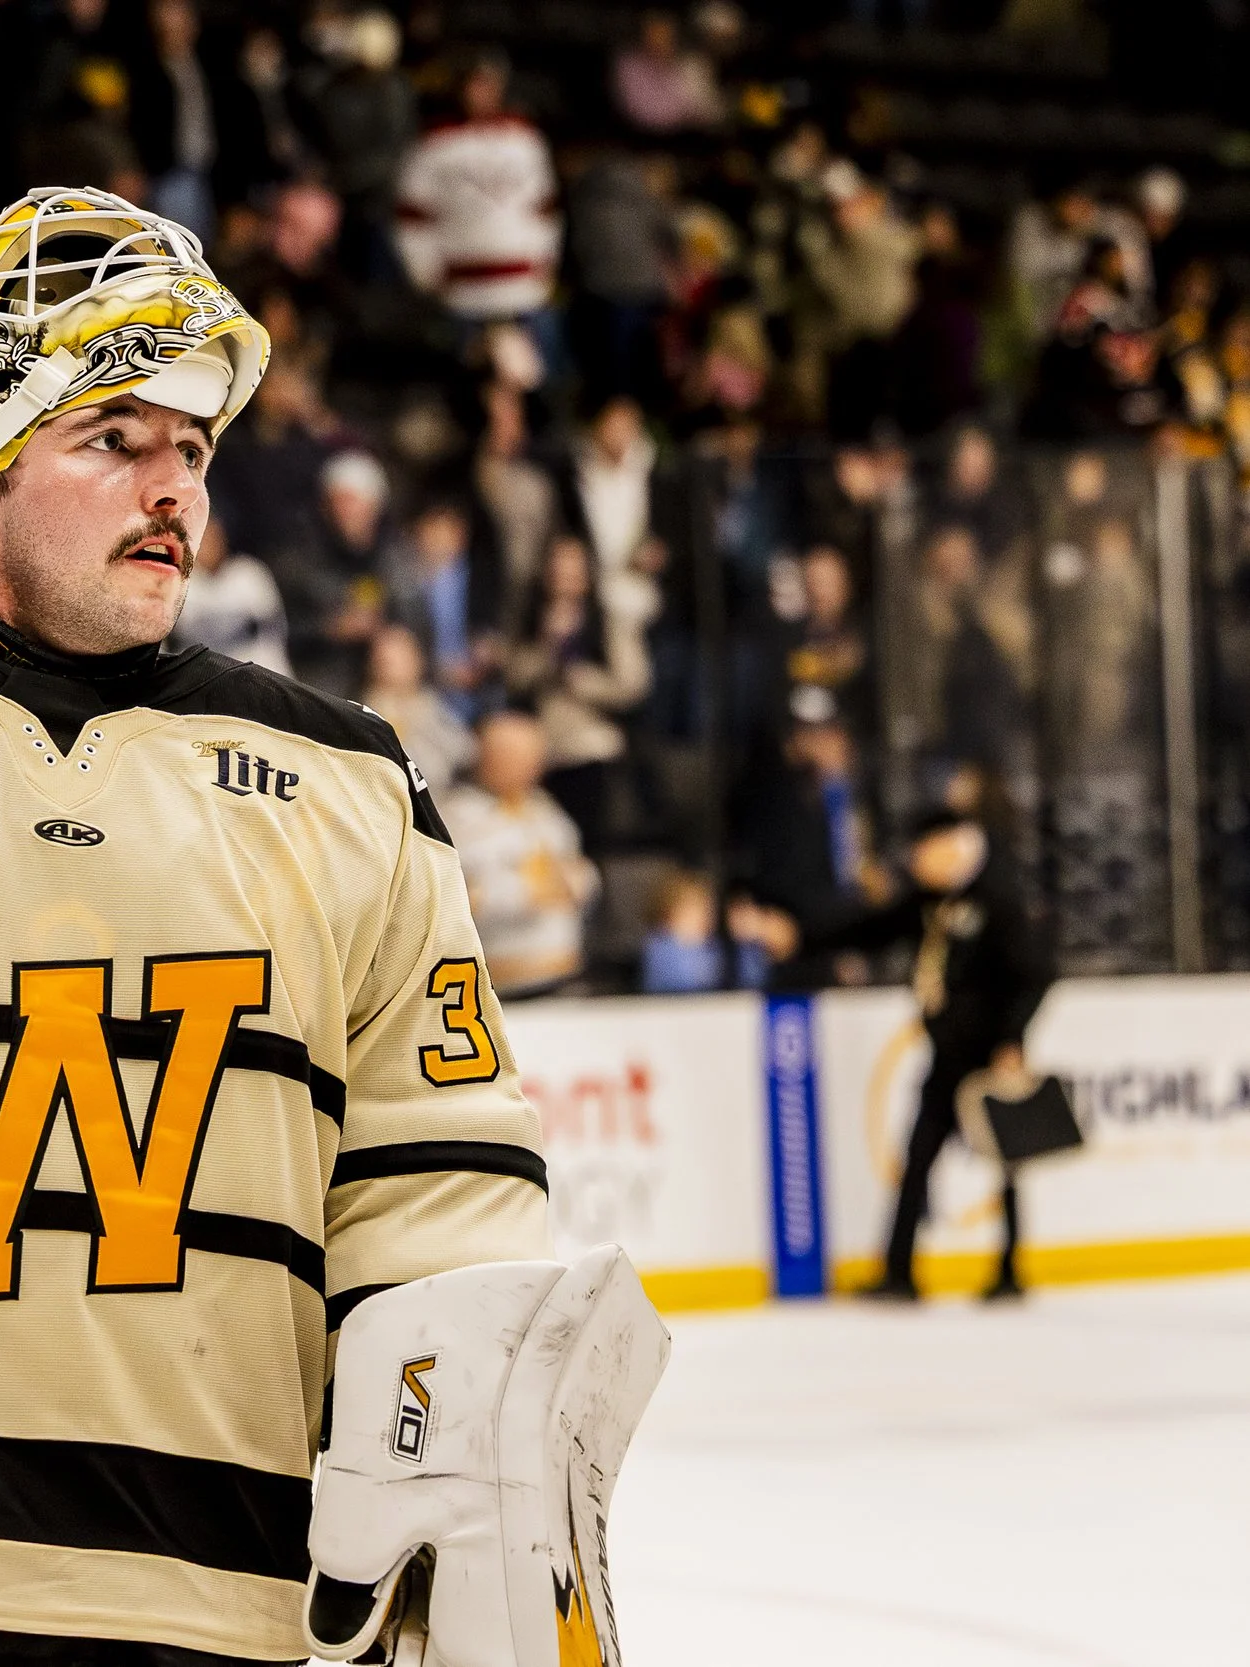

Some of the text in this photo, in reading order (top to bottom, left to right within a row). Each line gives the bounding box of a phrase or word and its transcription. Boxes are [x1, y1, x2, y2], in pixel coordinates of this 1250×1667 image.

[211, 748, 299, 802] Lite
[44, 821, 98, 843] AK
[418, 957, 500, 1088] 3
